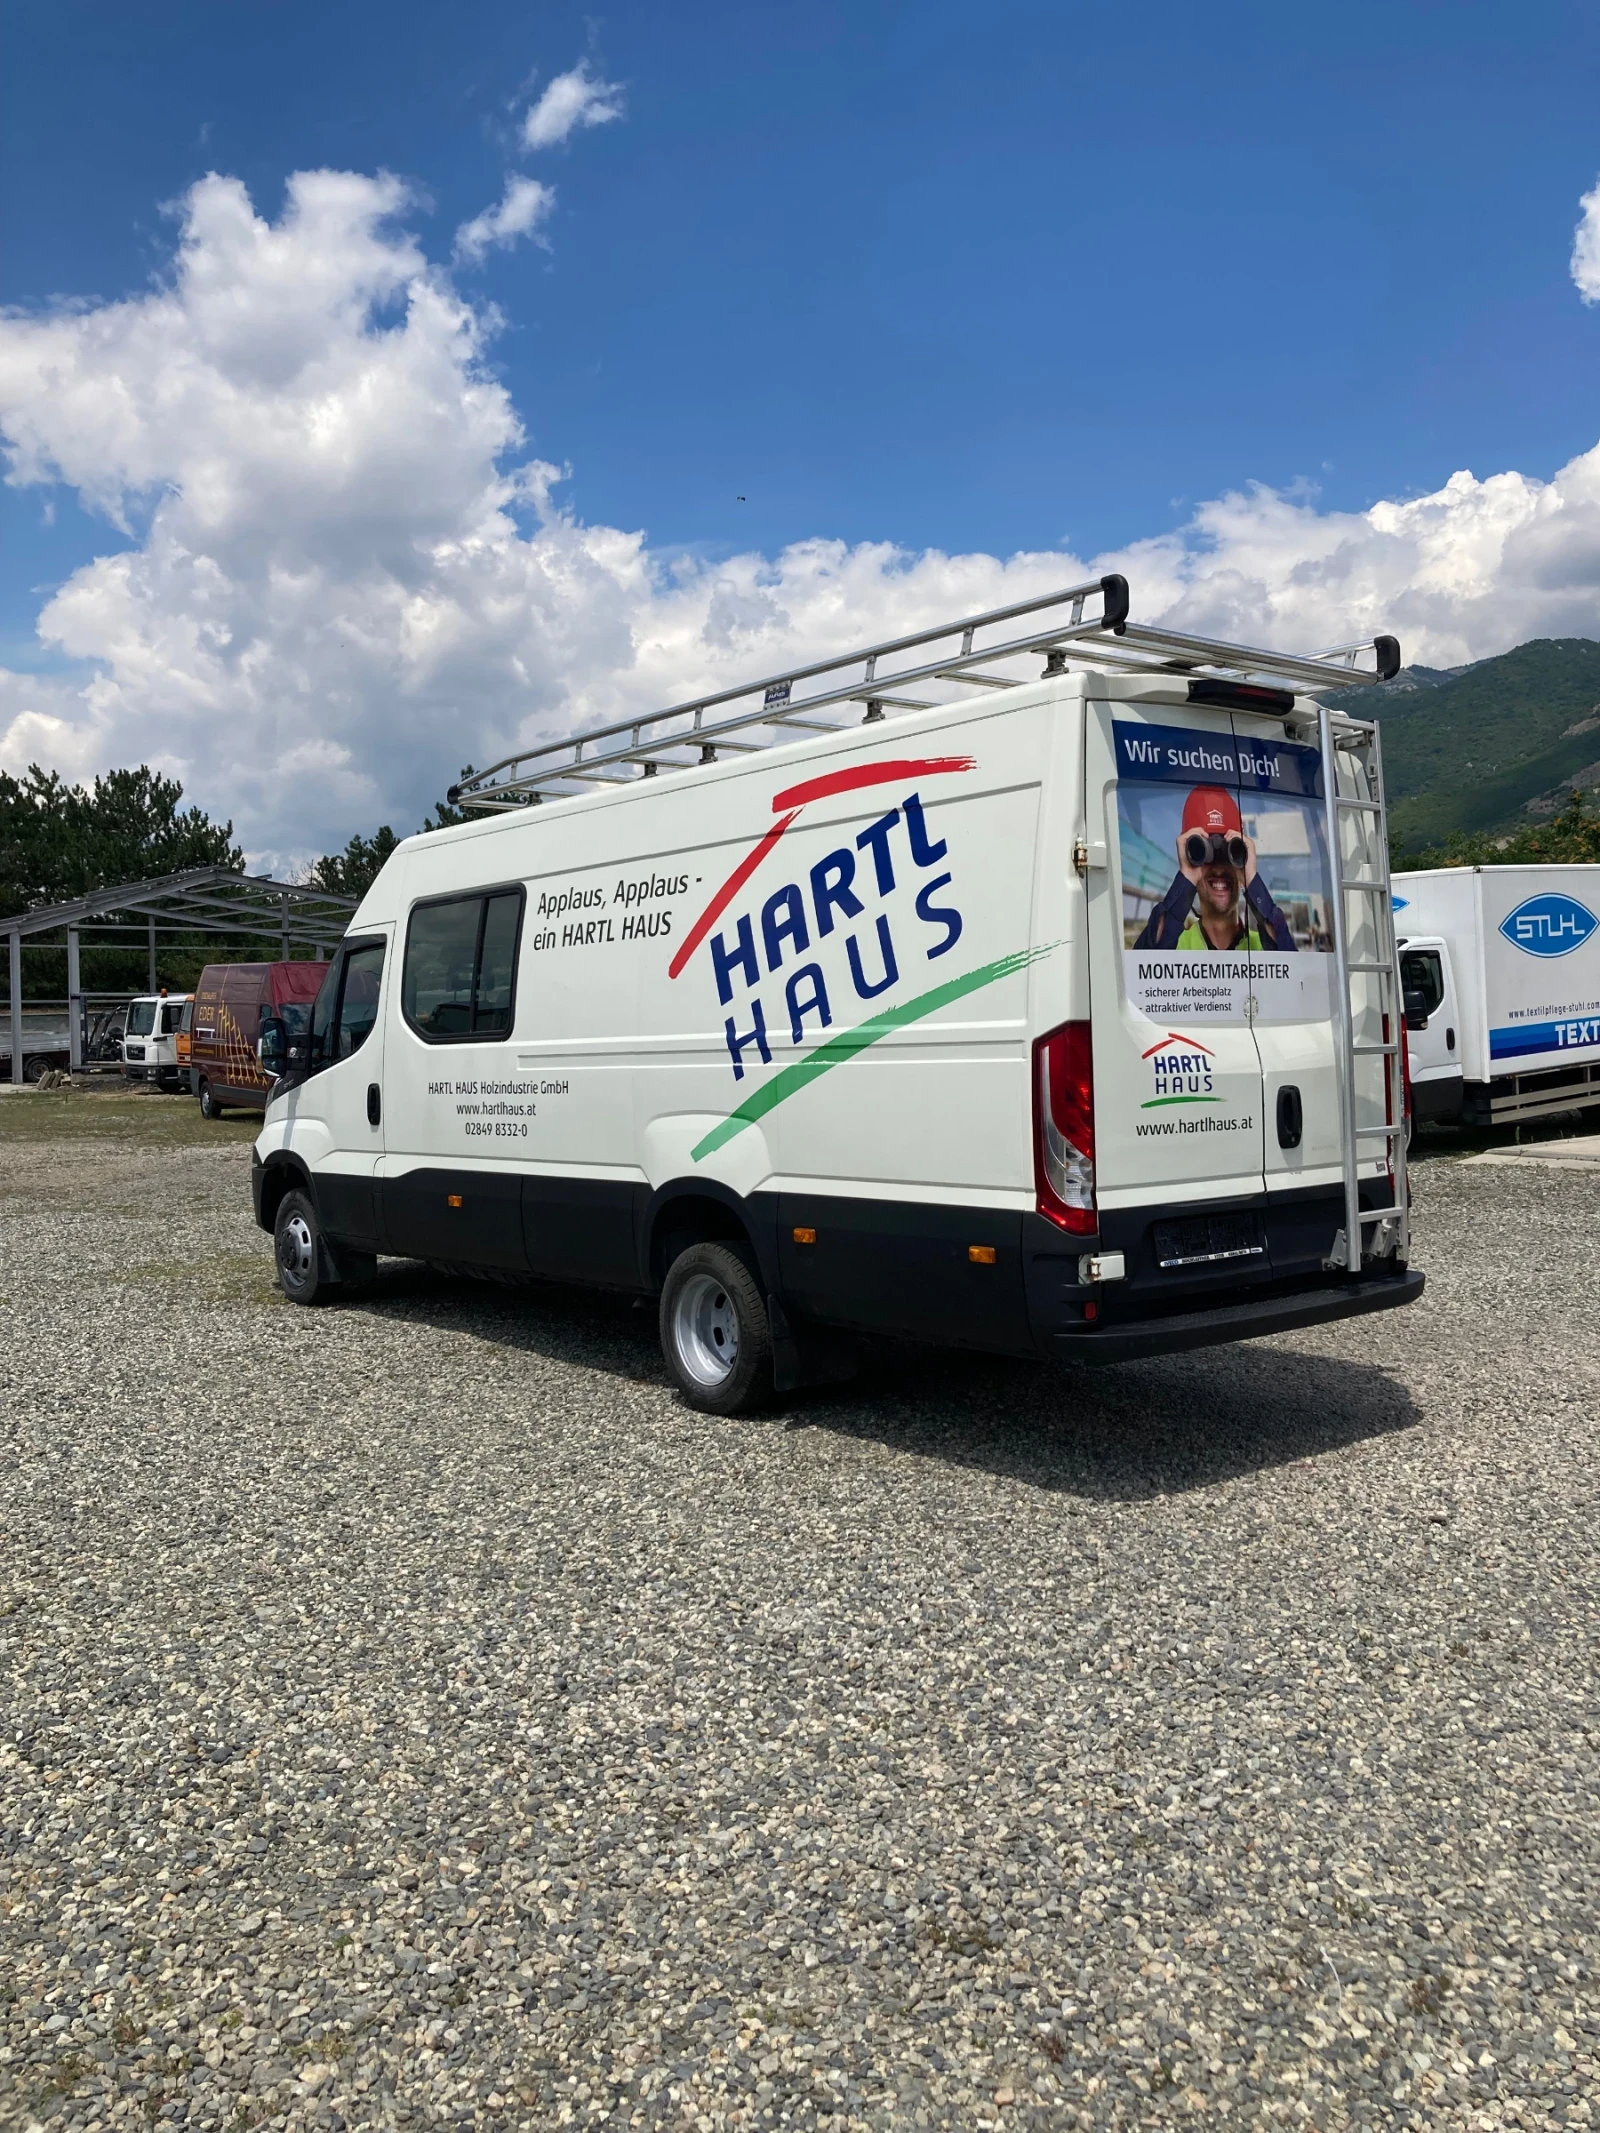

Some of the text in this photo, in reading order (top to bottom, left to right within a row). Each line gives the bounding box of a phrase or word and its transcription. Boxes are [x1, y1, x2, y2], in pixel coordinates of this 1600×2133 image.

[1124, 739, 1280, 778] Wir suchen Dich!
[537, 886, 607, 919] Applaus,
[613, 873, 689, 909] Applaus
[710, 792, 948, 1006] HARTL
[533, 911, 672, 951] ein HARTL HAUS
[1515, 913, 1586, 939] STUHL
[725, 872, 963, 1082] HAUS
[1138, 963, 1290, 980] MONTAGEMITARBEITER
[1144, 987, 1180, 998] sicherer
[1182, 986, 1232, 999] Arbeitsplatz
[1145, 1002, 1191, 1013] attraktiver
[1193, 1001, 1232, 1012] Verdienst
[1508, 1001, 1600, 1019] www.textilpflege-stuhl.com
[1555, 1020, 1600, 1046] TEXT
[1154, 1054, 1211, 1074] HARTL
[428, 1080, 569, 1095] HARTL HAUS Holzindustrie GmbH
[1155, 1075, 1213, 1094] HAUS
[456, 1101, 537, 1116] www.hartlhaus.at
[465, 1122, 528, 1137] 02849 8332-0
[1136, 1116, 1253, 1136] www.hartlhaus.at
